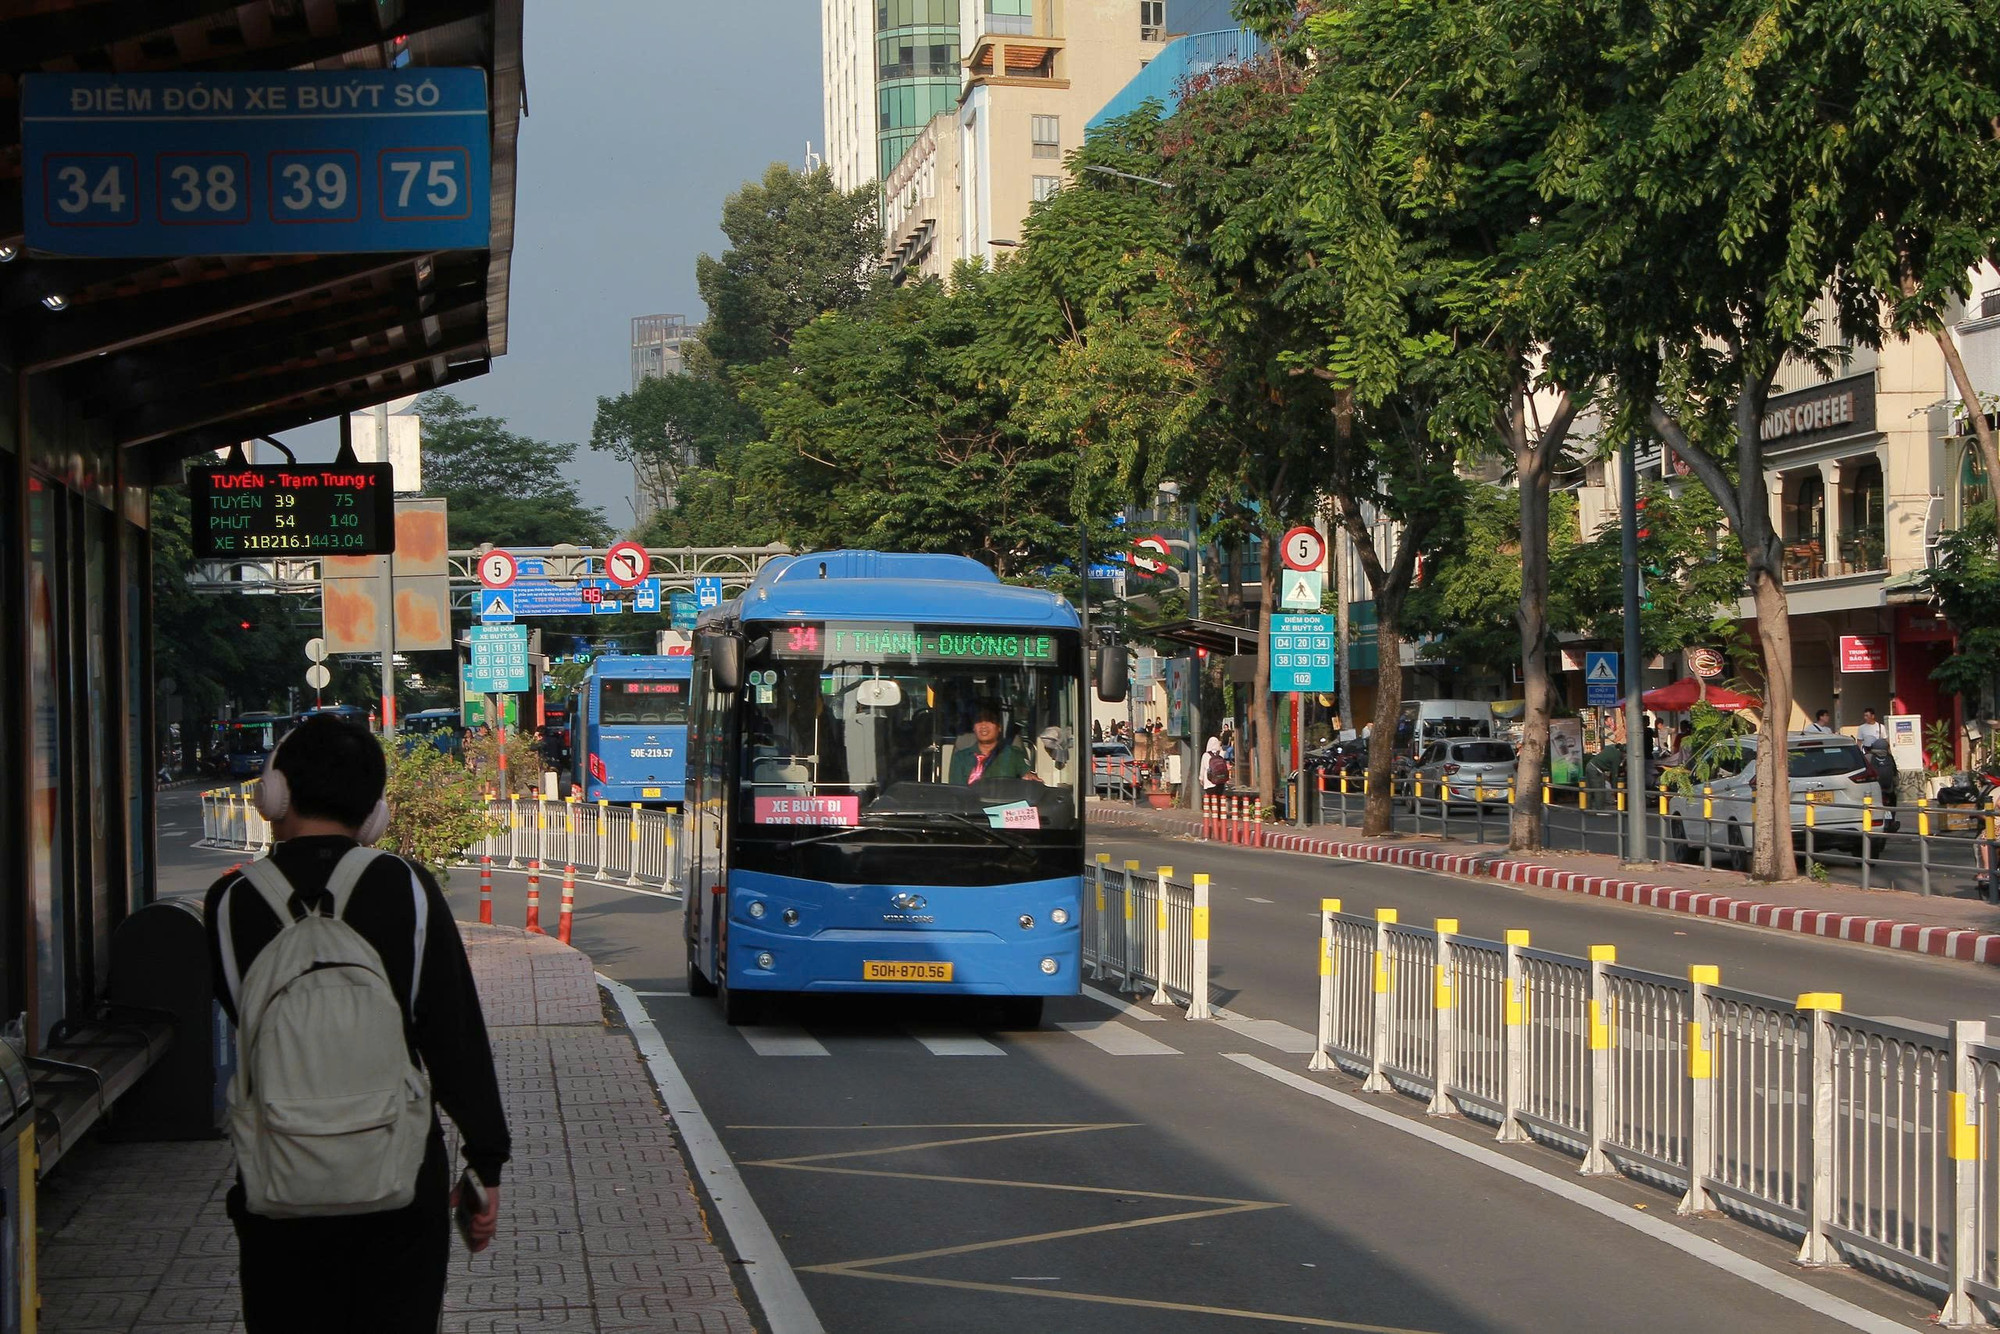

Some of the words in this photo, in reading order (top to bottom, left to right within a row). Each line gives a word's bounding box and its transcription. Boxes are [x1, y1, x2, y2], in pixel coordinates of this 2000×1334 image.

[70, 83, 151, 111] ĐIỂM
[162, 81, 233, 111] ĐÓN
[245, 87, 287, 110] XE
[298, 80, 384, 109] BUÝT
[394, 78, 440, 107] SỐ
[57, 165, 126, 213] 34
[170, 165, 237, 212] 38
[281, 162, 348, 210] 39
[390, 160, 458, 207] 75
[1795, 394, 1849, 432] COFFEE
[211, 471, 264, 488] TUYẾN
[278, 473, 318, 490] Trạm
[321, 472, 365, 490] Trung
[210, 492, 262, 508] TUYẾN
[275, 494, 295, 508] 39
[334, 494, 353, 507] 75
[210, 514, 251, 529] PHÚT
[275, 514, 295, 528] 54
[329, 514, 358, 527] 140
[215, 536, 234, 549] XE
[1299, 540, 1308, 558] 5
[494, 561, 502, 577] 5
[495, 644, 504, 652] 18
[512, 643, 521, 651] 31
[788, 627, 818, 651] 34
[938, 632, 1018, 657] ĐƯỜNG
[1277, 638, 1289, 647] D4
[1297, 638, 1307, 647] 20
[1316, 638, 1326, 647] 34
[478, 657, 488, 665] 36
[495, 656, 504, 664] 44
[512, 656, 521, 664] 52
[1278, 656, 1289, 665] 38
[1297, 656, 1307, 665] 39
[1316, 656, 1326, 665] 75
[495, 668, 505, 676] 93
[511, 668, 523, 676] 109
[1295, 674, 1310, 683] 102
[494, 681, 507, 689] 152
[630, 748, 674, 758] 50E-219.57
[772, 800, 788, 812] XE
[792, 797, 825, 812] BUÝT
[827, 800, 841, 812] ĐI
[883, 914, 904, 923] KIM
[905, 915, 934, 923] LONG
[871, 964, 945, 978] 50H-870.56
